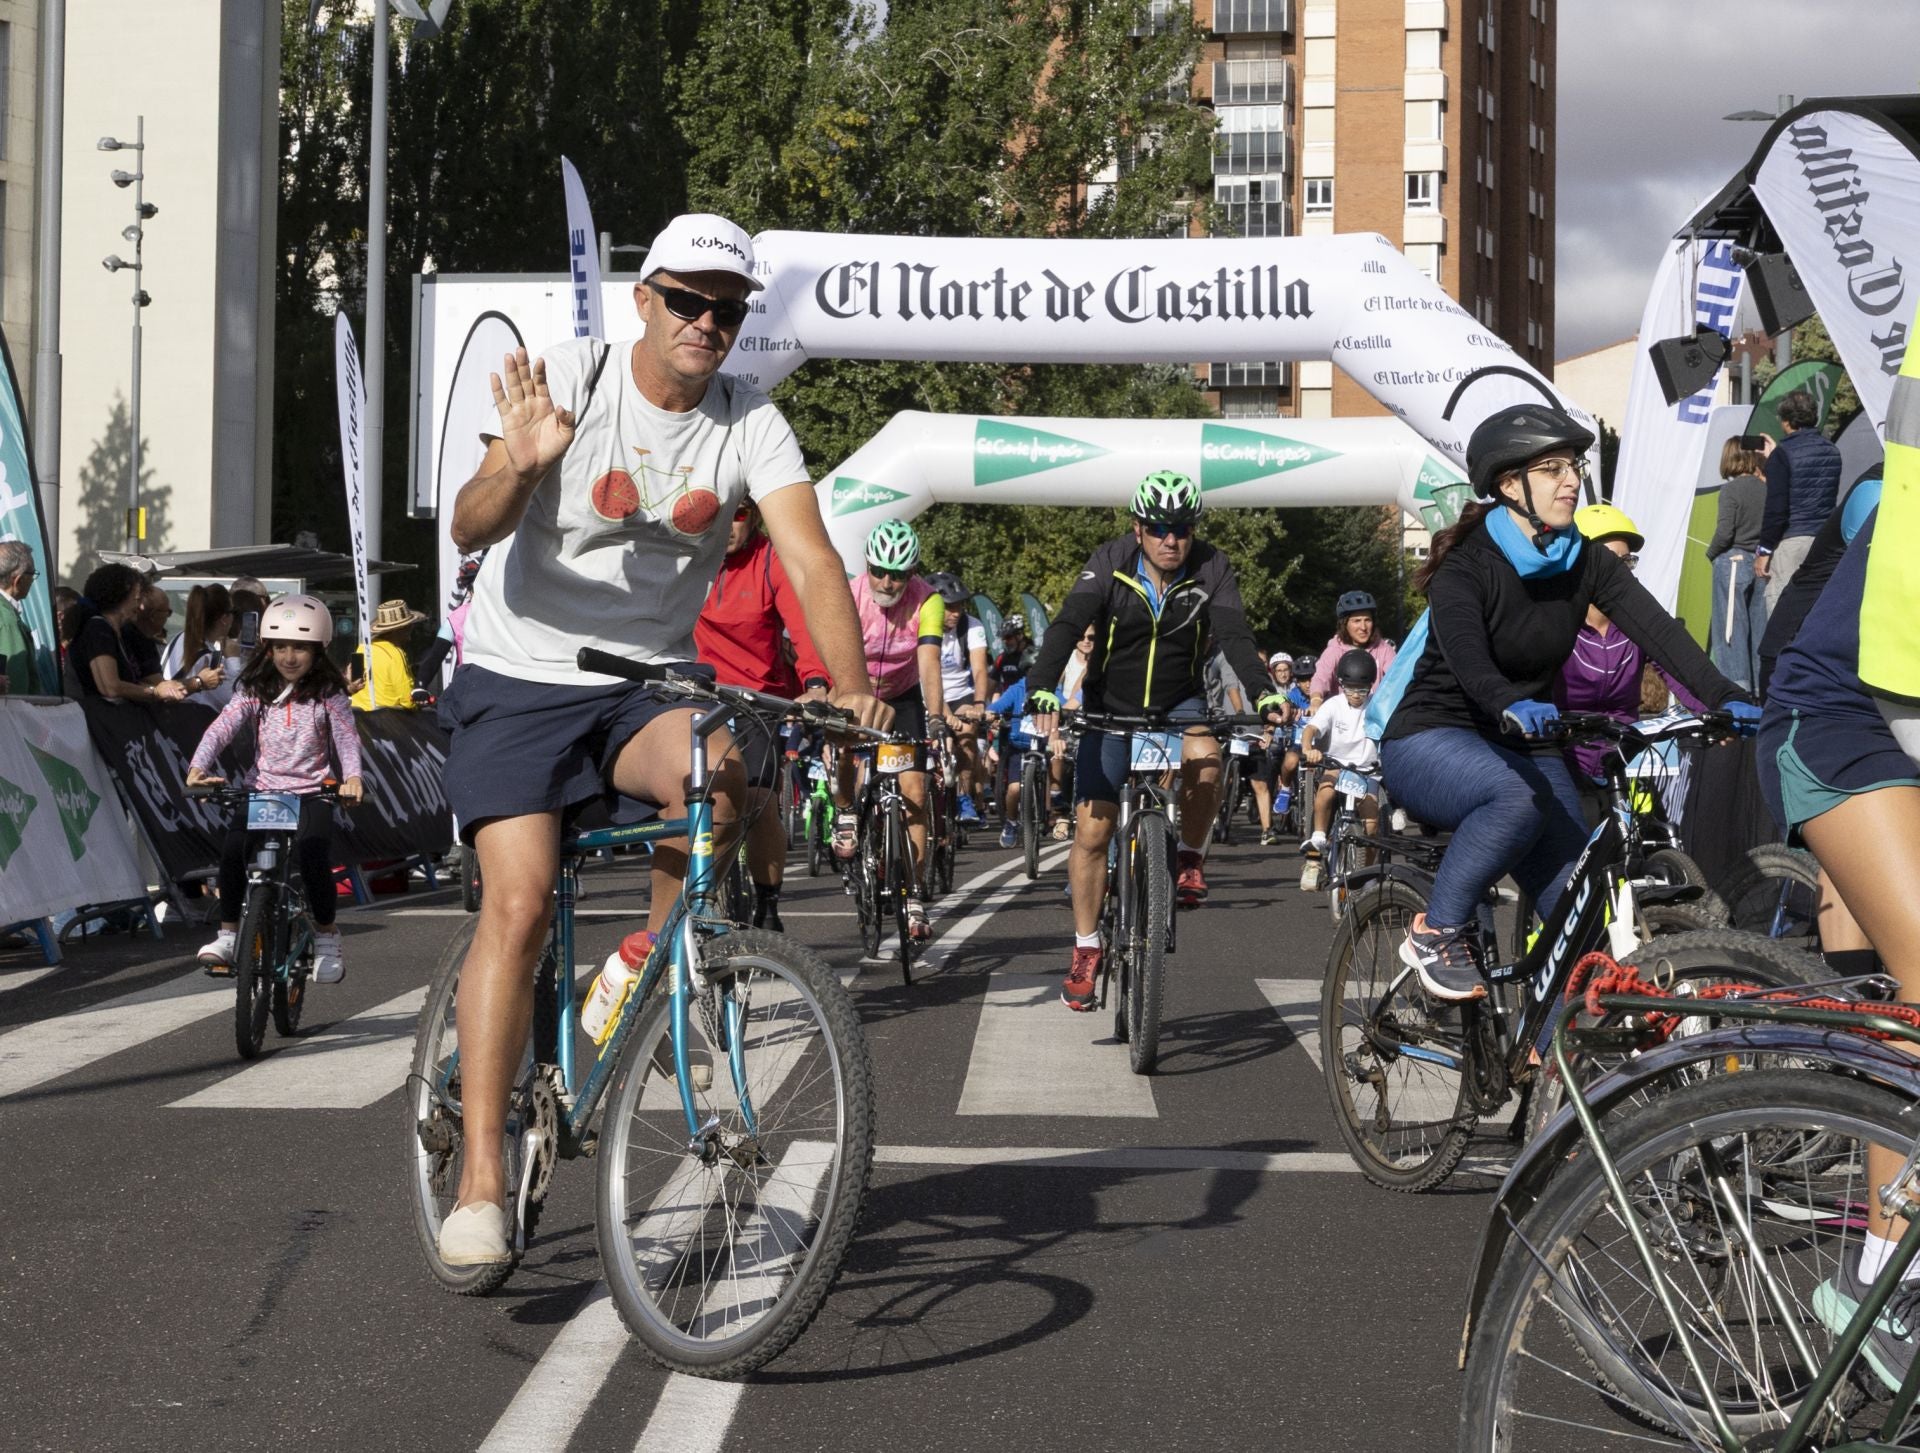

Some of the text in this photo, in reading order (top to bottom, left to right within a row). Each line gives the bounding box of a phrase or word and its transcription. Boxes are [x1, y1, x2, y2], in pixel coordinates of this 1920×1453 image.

[1361, 260, 1387, 274] tilla
[816, 261, 1316, 324] El Norte de Castilla
[1385, 296, 1418, 311] Norte
[1421, 299, 1433, 311] de
[739, 336, 756, 352] El
[760, 337, 793, 351] Norte
[1342, 335, 1392, 350] Castilla
[1391, 370, 1425, 386] Norte
[1428, 371, 1440, 384] de
[880, 753, 912, 768] 1093
[1141, 747, 1172, 763] 377
[257, 808, 288, 822] 354
